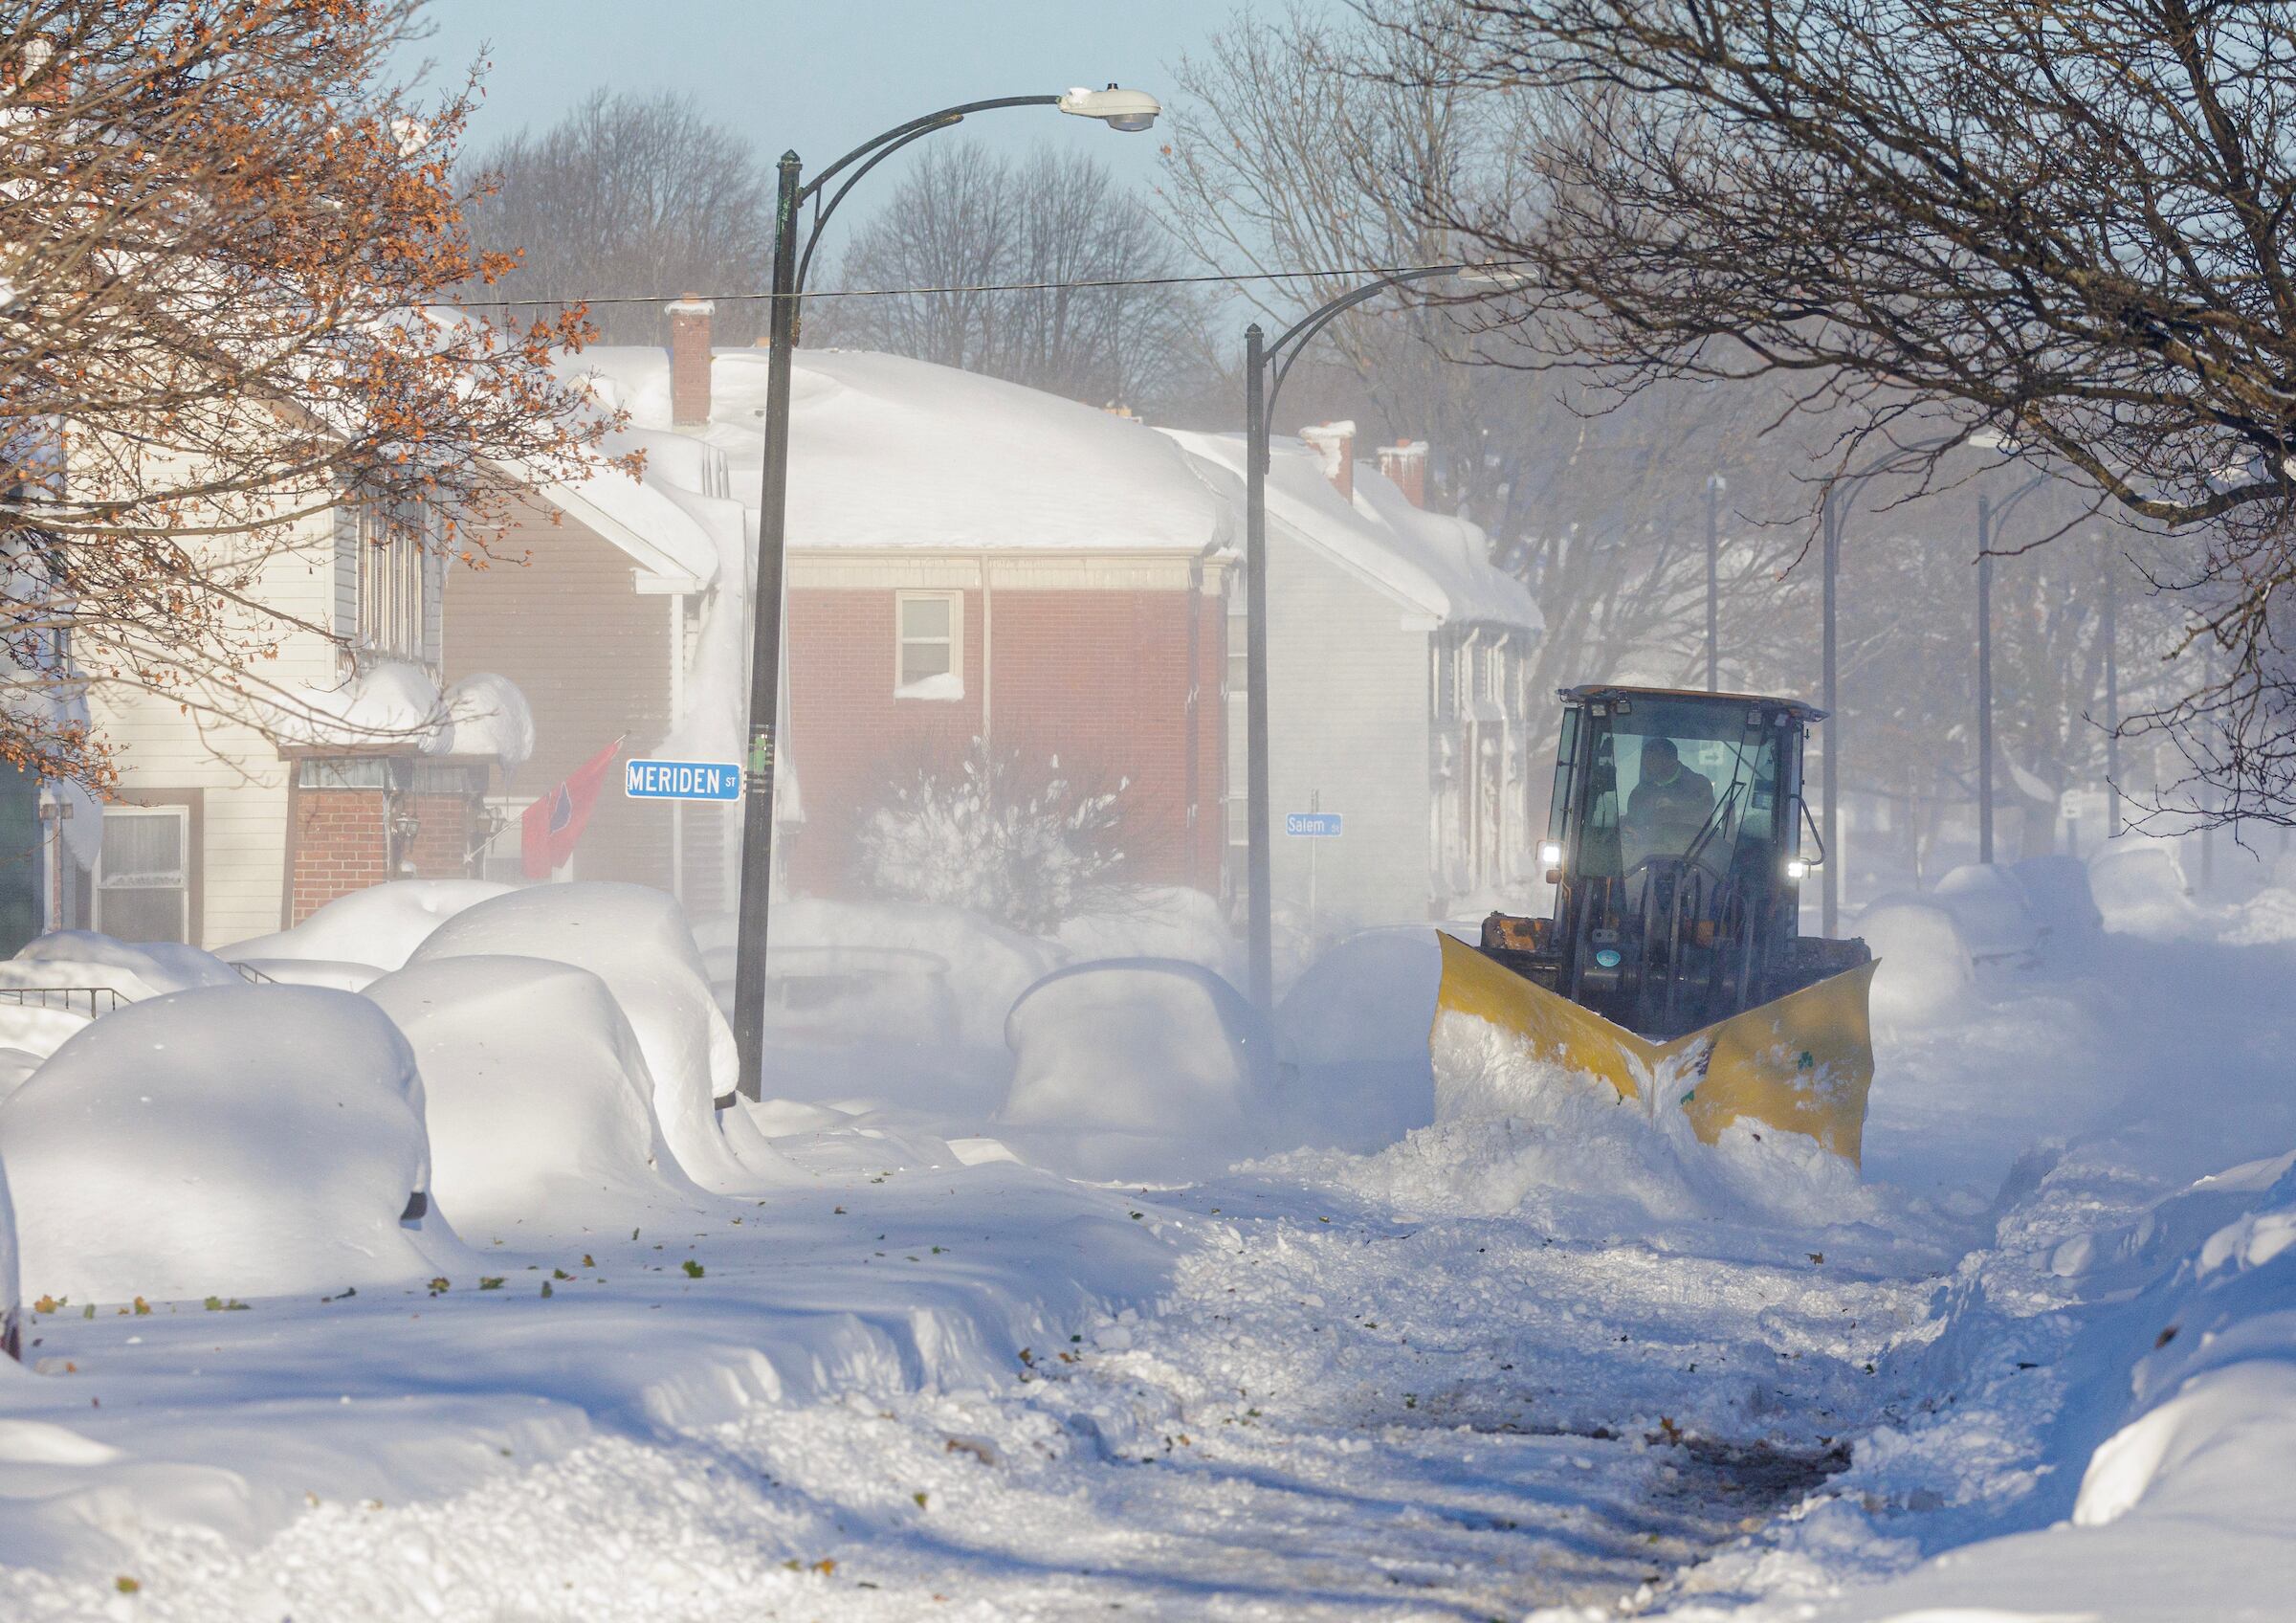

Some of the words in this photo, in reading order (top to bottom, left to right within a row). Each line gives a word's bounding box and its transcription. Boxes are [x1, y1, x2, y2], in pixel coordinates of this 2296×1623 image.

[629, 767, 719, 793] MERIDEN
[725, 777, 736, 787] ST
[1289, 817, 1325, 833] Salem
